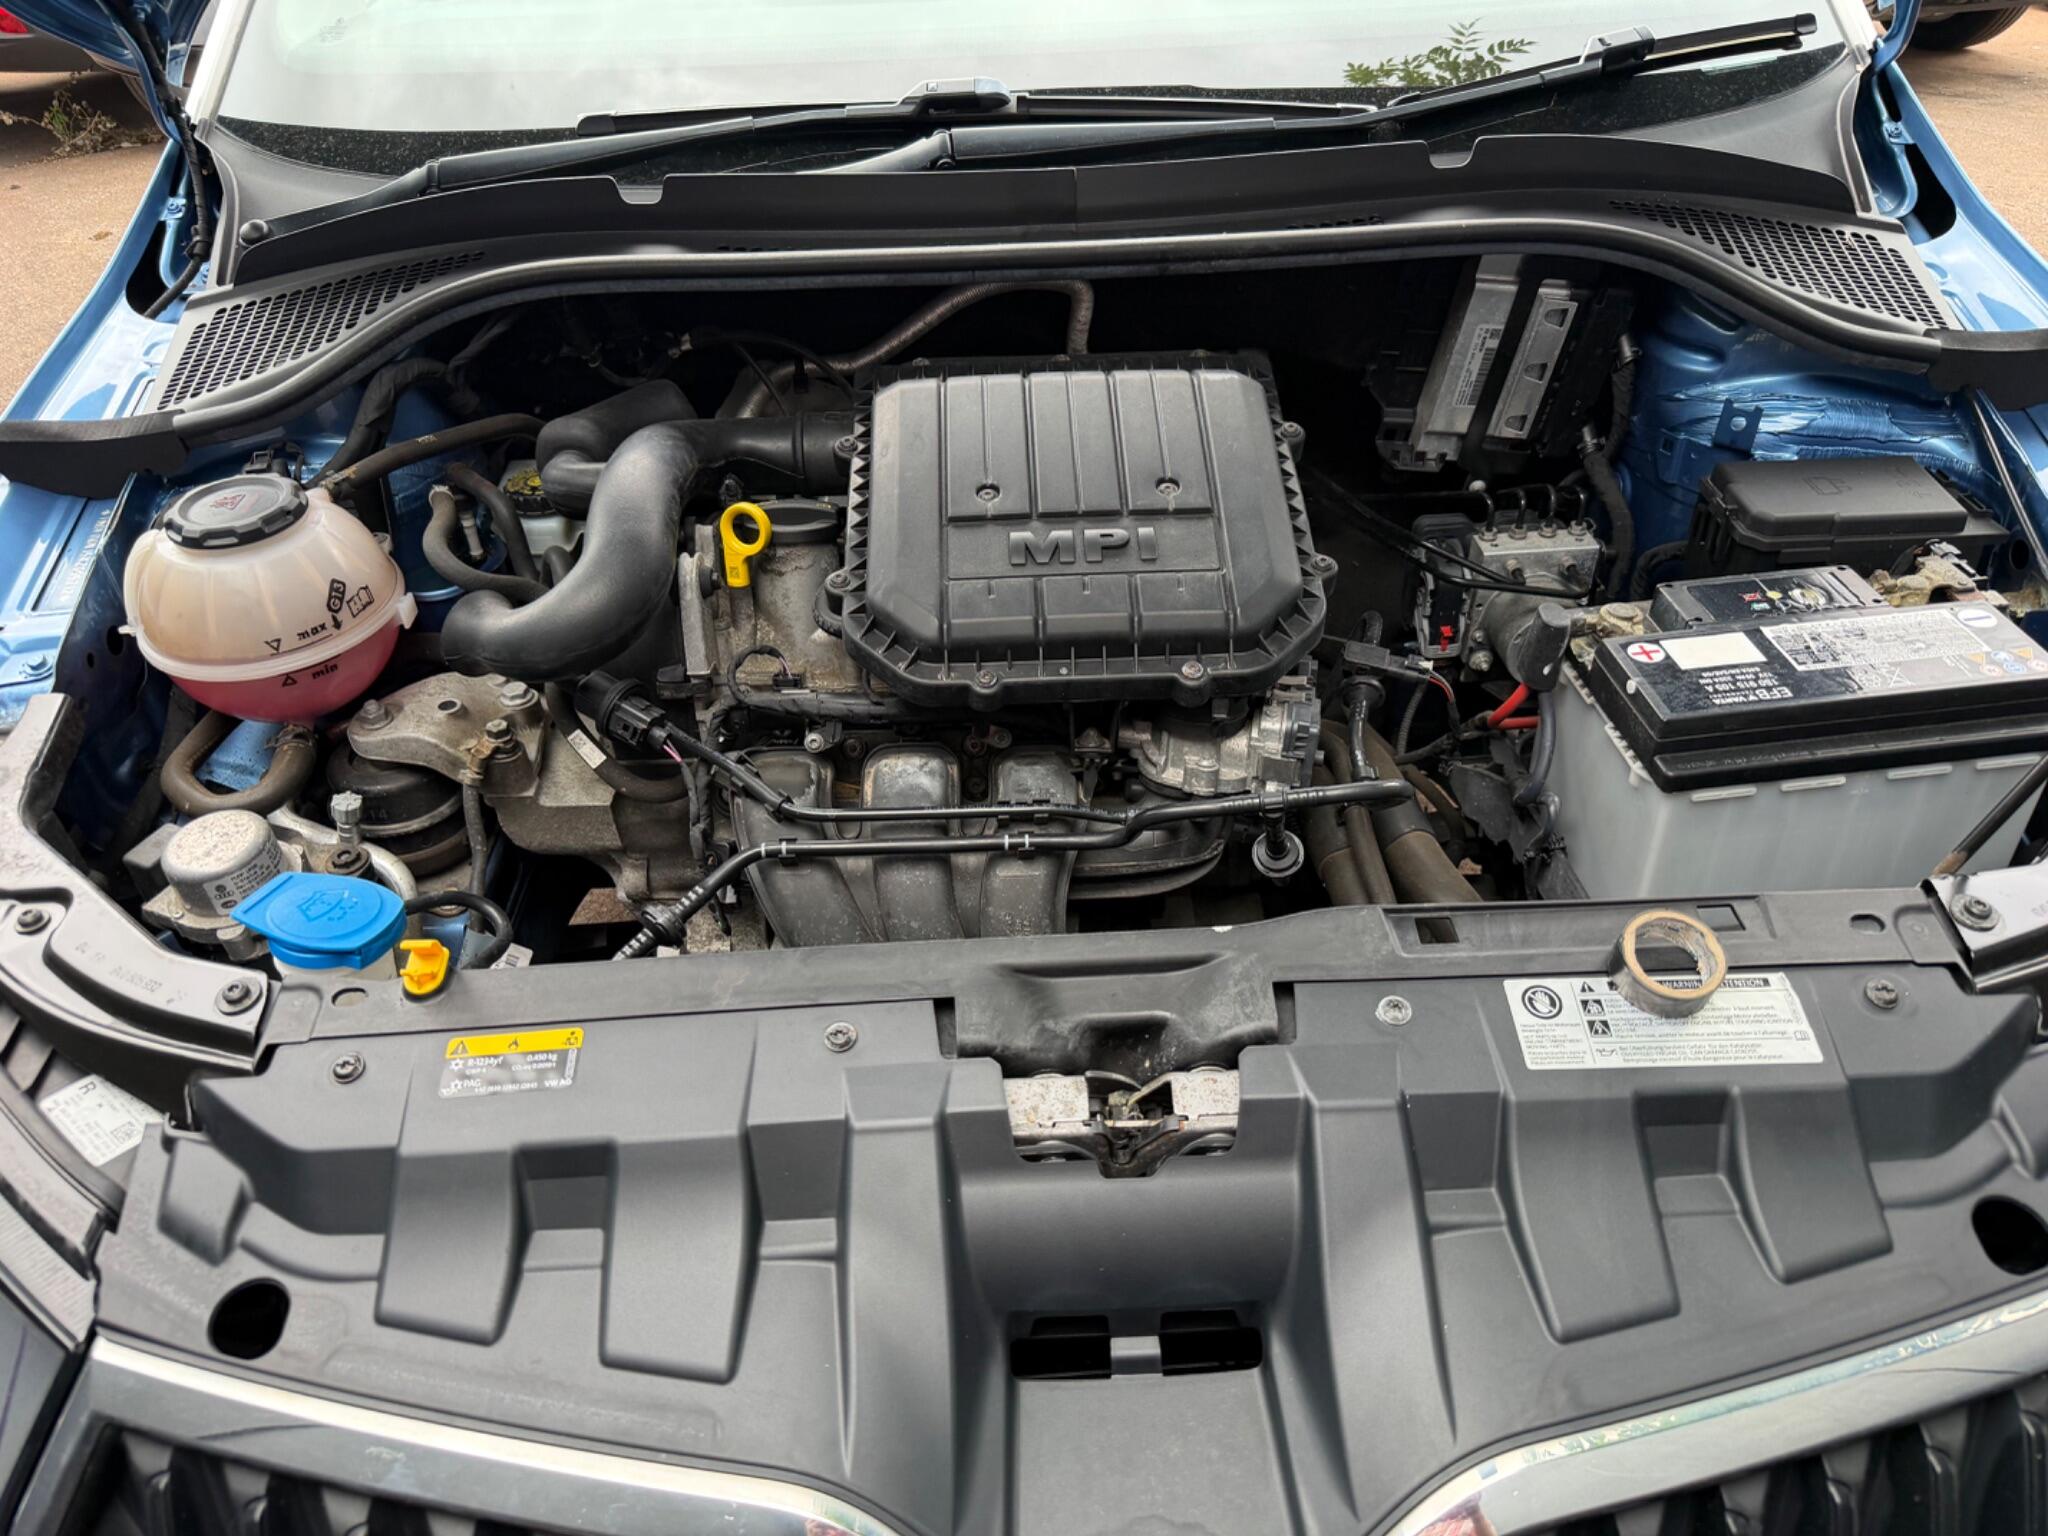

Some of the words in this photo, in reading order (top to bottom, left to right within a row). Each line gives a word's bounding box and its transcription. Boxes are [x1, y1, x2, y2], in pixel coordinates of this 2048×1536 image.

[1009, 526, 1158, 566] MPI
[297, 621, 328, 641] max
[312, 662, 339, 680] min
[1711, 695, 1747, 705] VARTA
[1755, 686, 1794, 701] EFB
[78, 1081, 97, 1095] R
